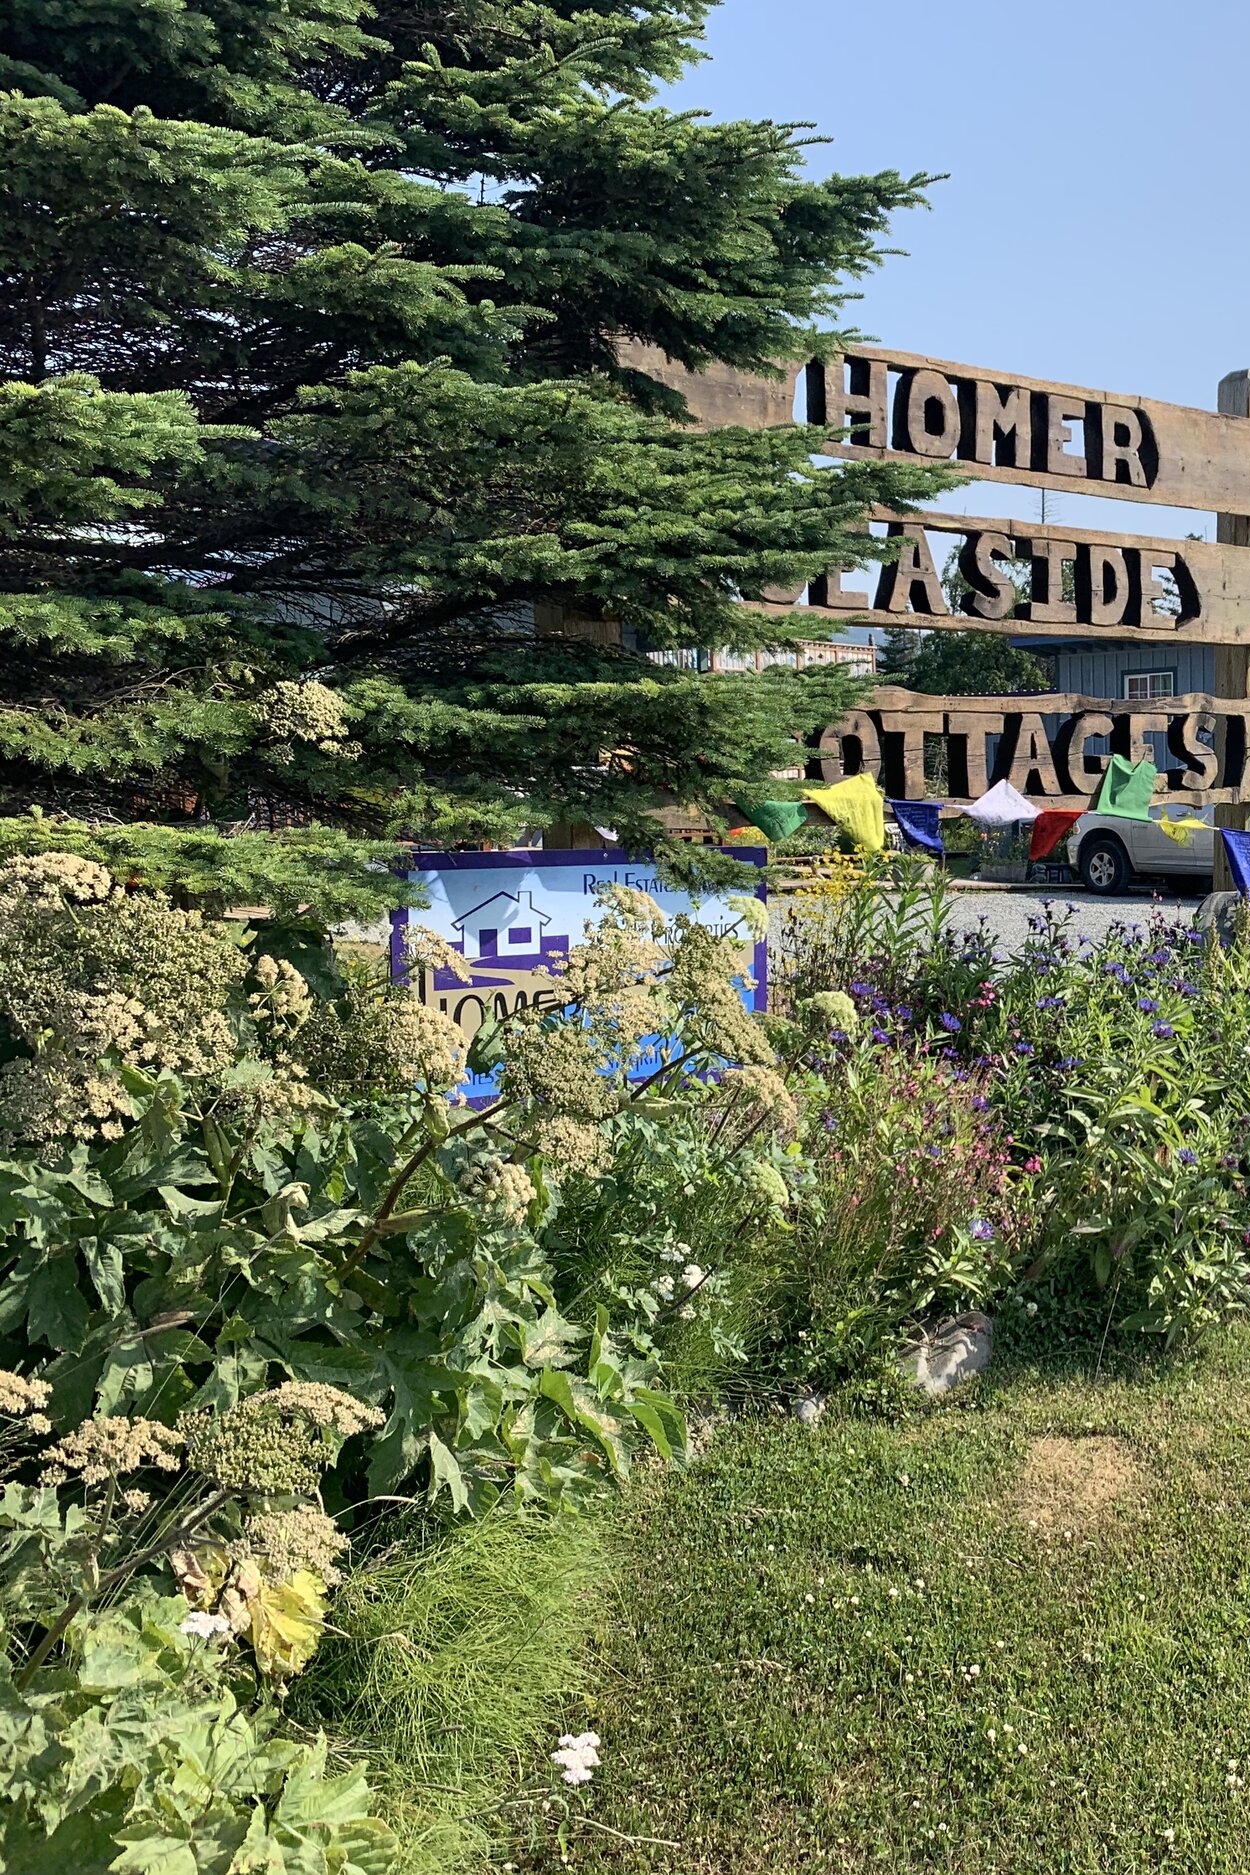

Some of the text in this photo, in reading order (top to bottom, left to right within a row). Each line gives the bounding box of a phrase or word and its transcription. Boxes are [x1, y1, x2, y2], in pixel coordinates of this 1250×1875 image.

[824, 353, 1148, 488] HOMER
[757, 522, 1178, 631] EASIDE
[818, 704, 1219, 801] OTTAGES
